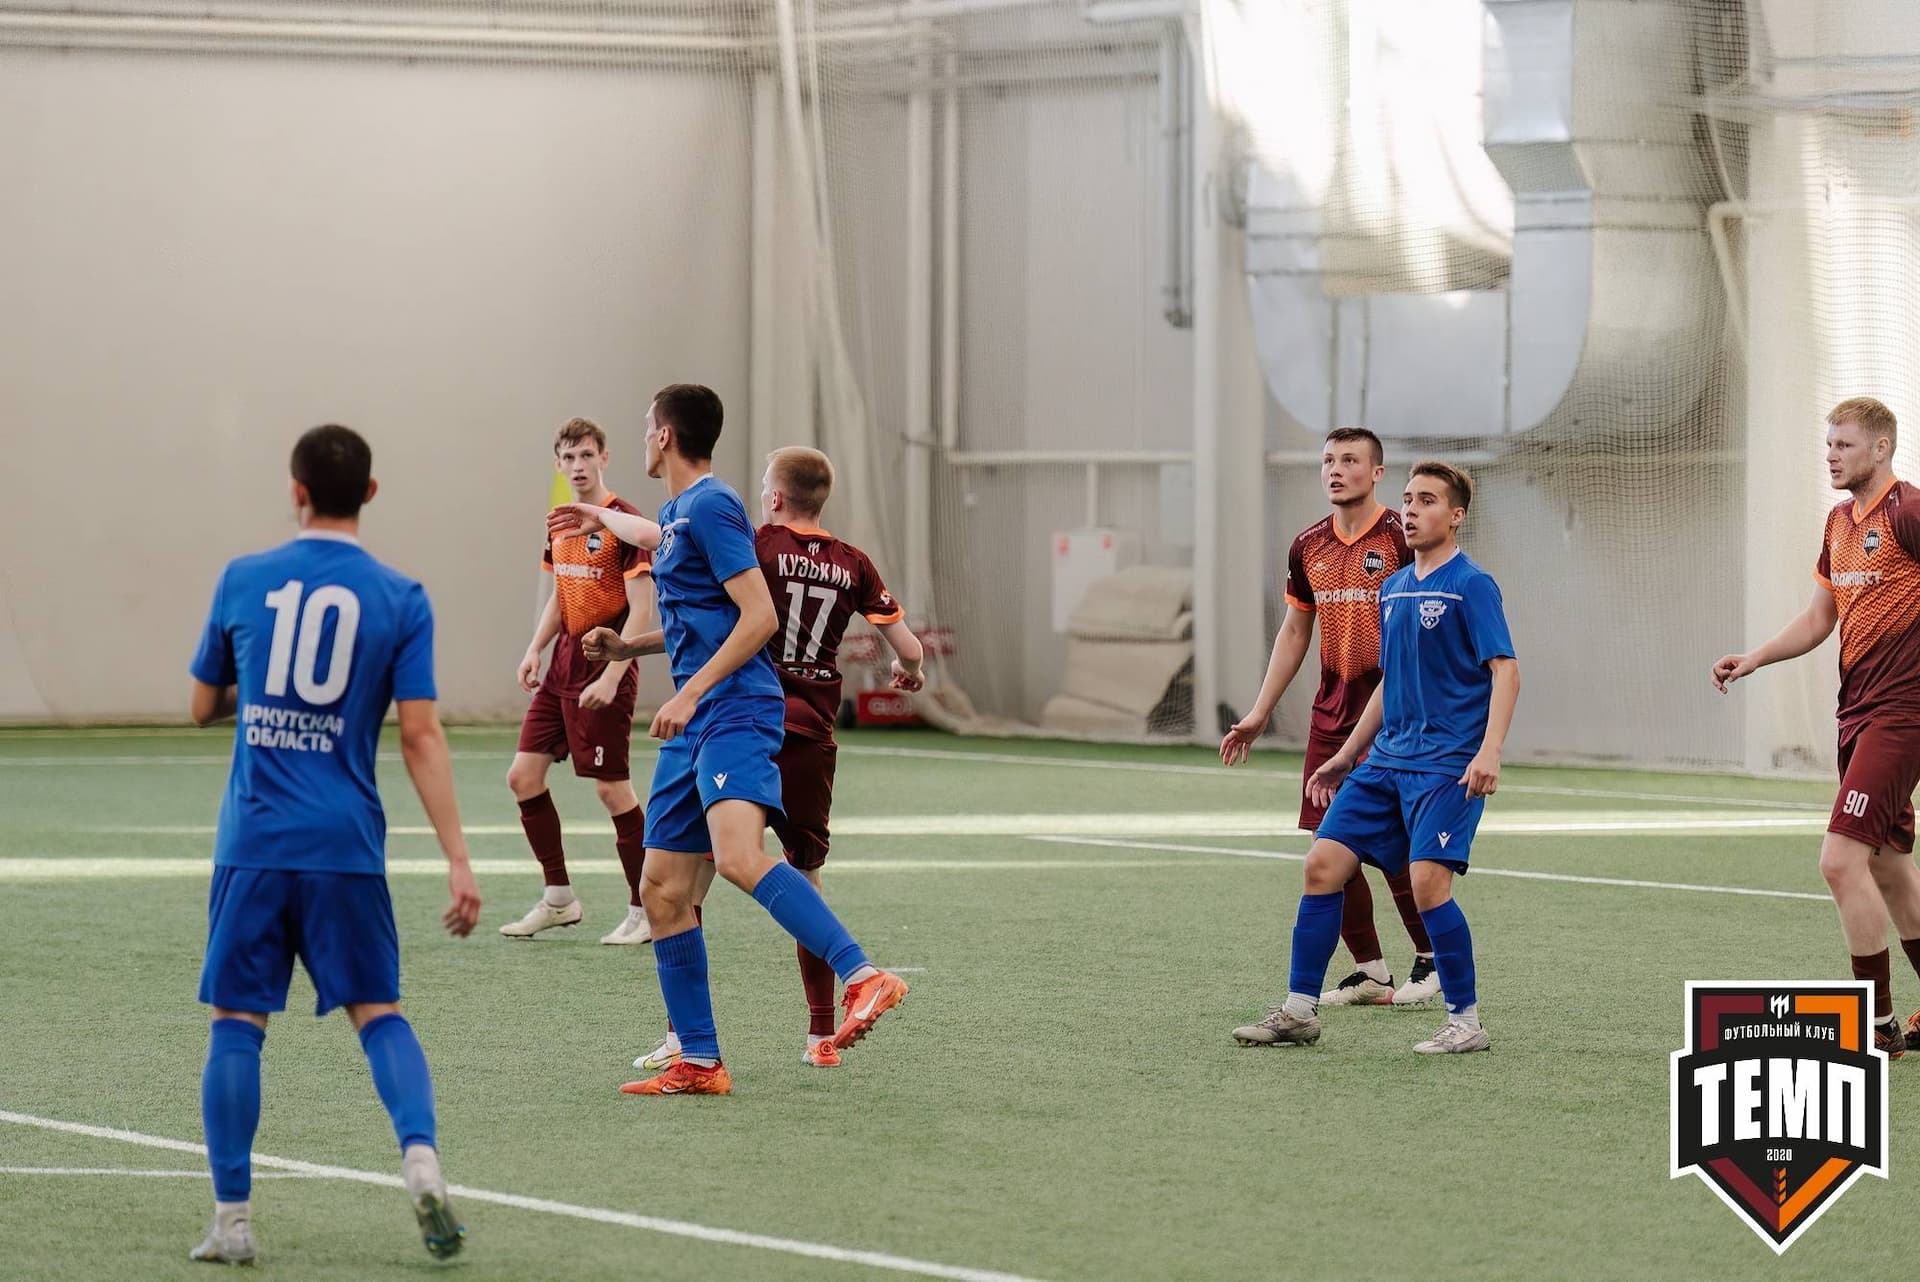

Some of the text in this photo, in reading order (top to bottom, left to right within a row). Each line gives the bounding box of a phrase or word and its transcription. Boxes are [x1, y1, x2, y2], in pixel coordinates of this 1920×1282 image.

[777, 553, 852, 590] КУЗЬКИН
[783, 581, 838, 663] 17
[264, 579, 361, 706] 10
[245, 725, 334, 753] ОБЛАСТЬ
[594, 746, 604, 767] 3
[1843, 789, 1870, 818] 90
